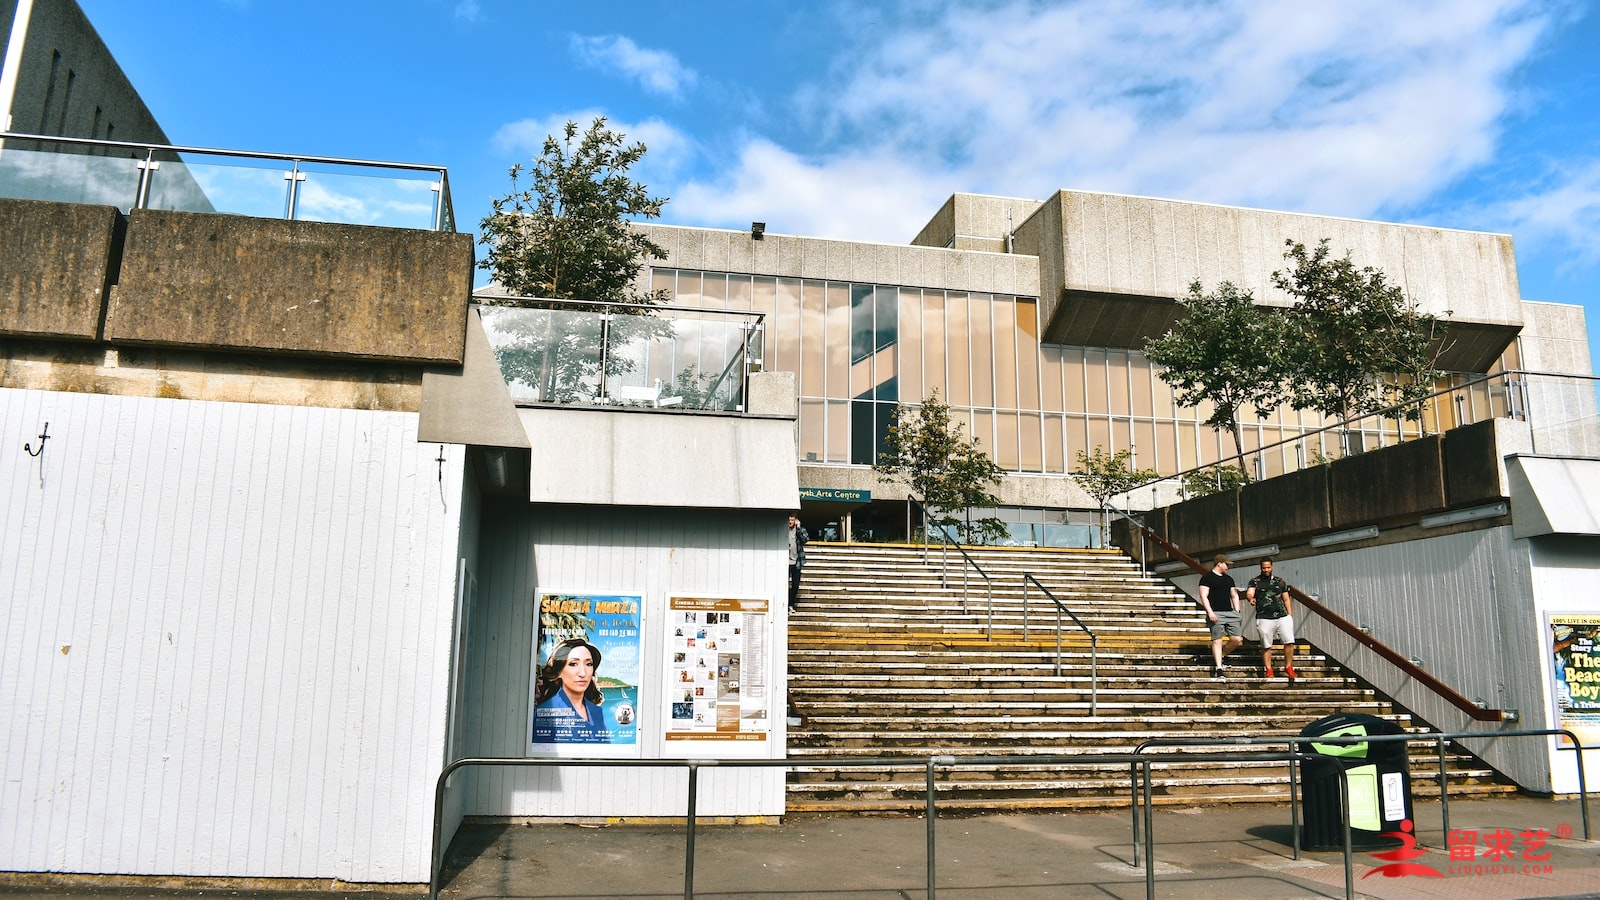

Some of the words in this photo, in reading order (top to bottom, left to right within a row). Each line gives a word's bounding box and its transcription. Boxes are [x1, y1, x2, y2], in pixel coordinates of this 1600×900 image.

[816, 490, 832, 498] Arts
[834, 491, 860, 499] Centre
[541, 597, 590, 613] SHAZIA
[595, 600, 637, 614] MIRZA
[1570, 644, 1592, 653] Story
[1571, 653, 1600, 668] The
[1569, 682, 1600, 700] Boy
